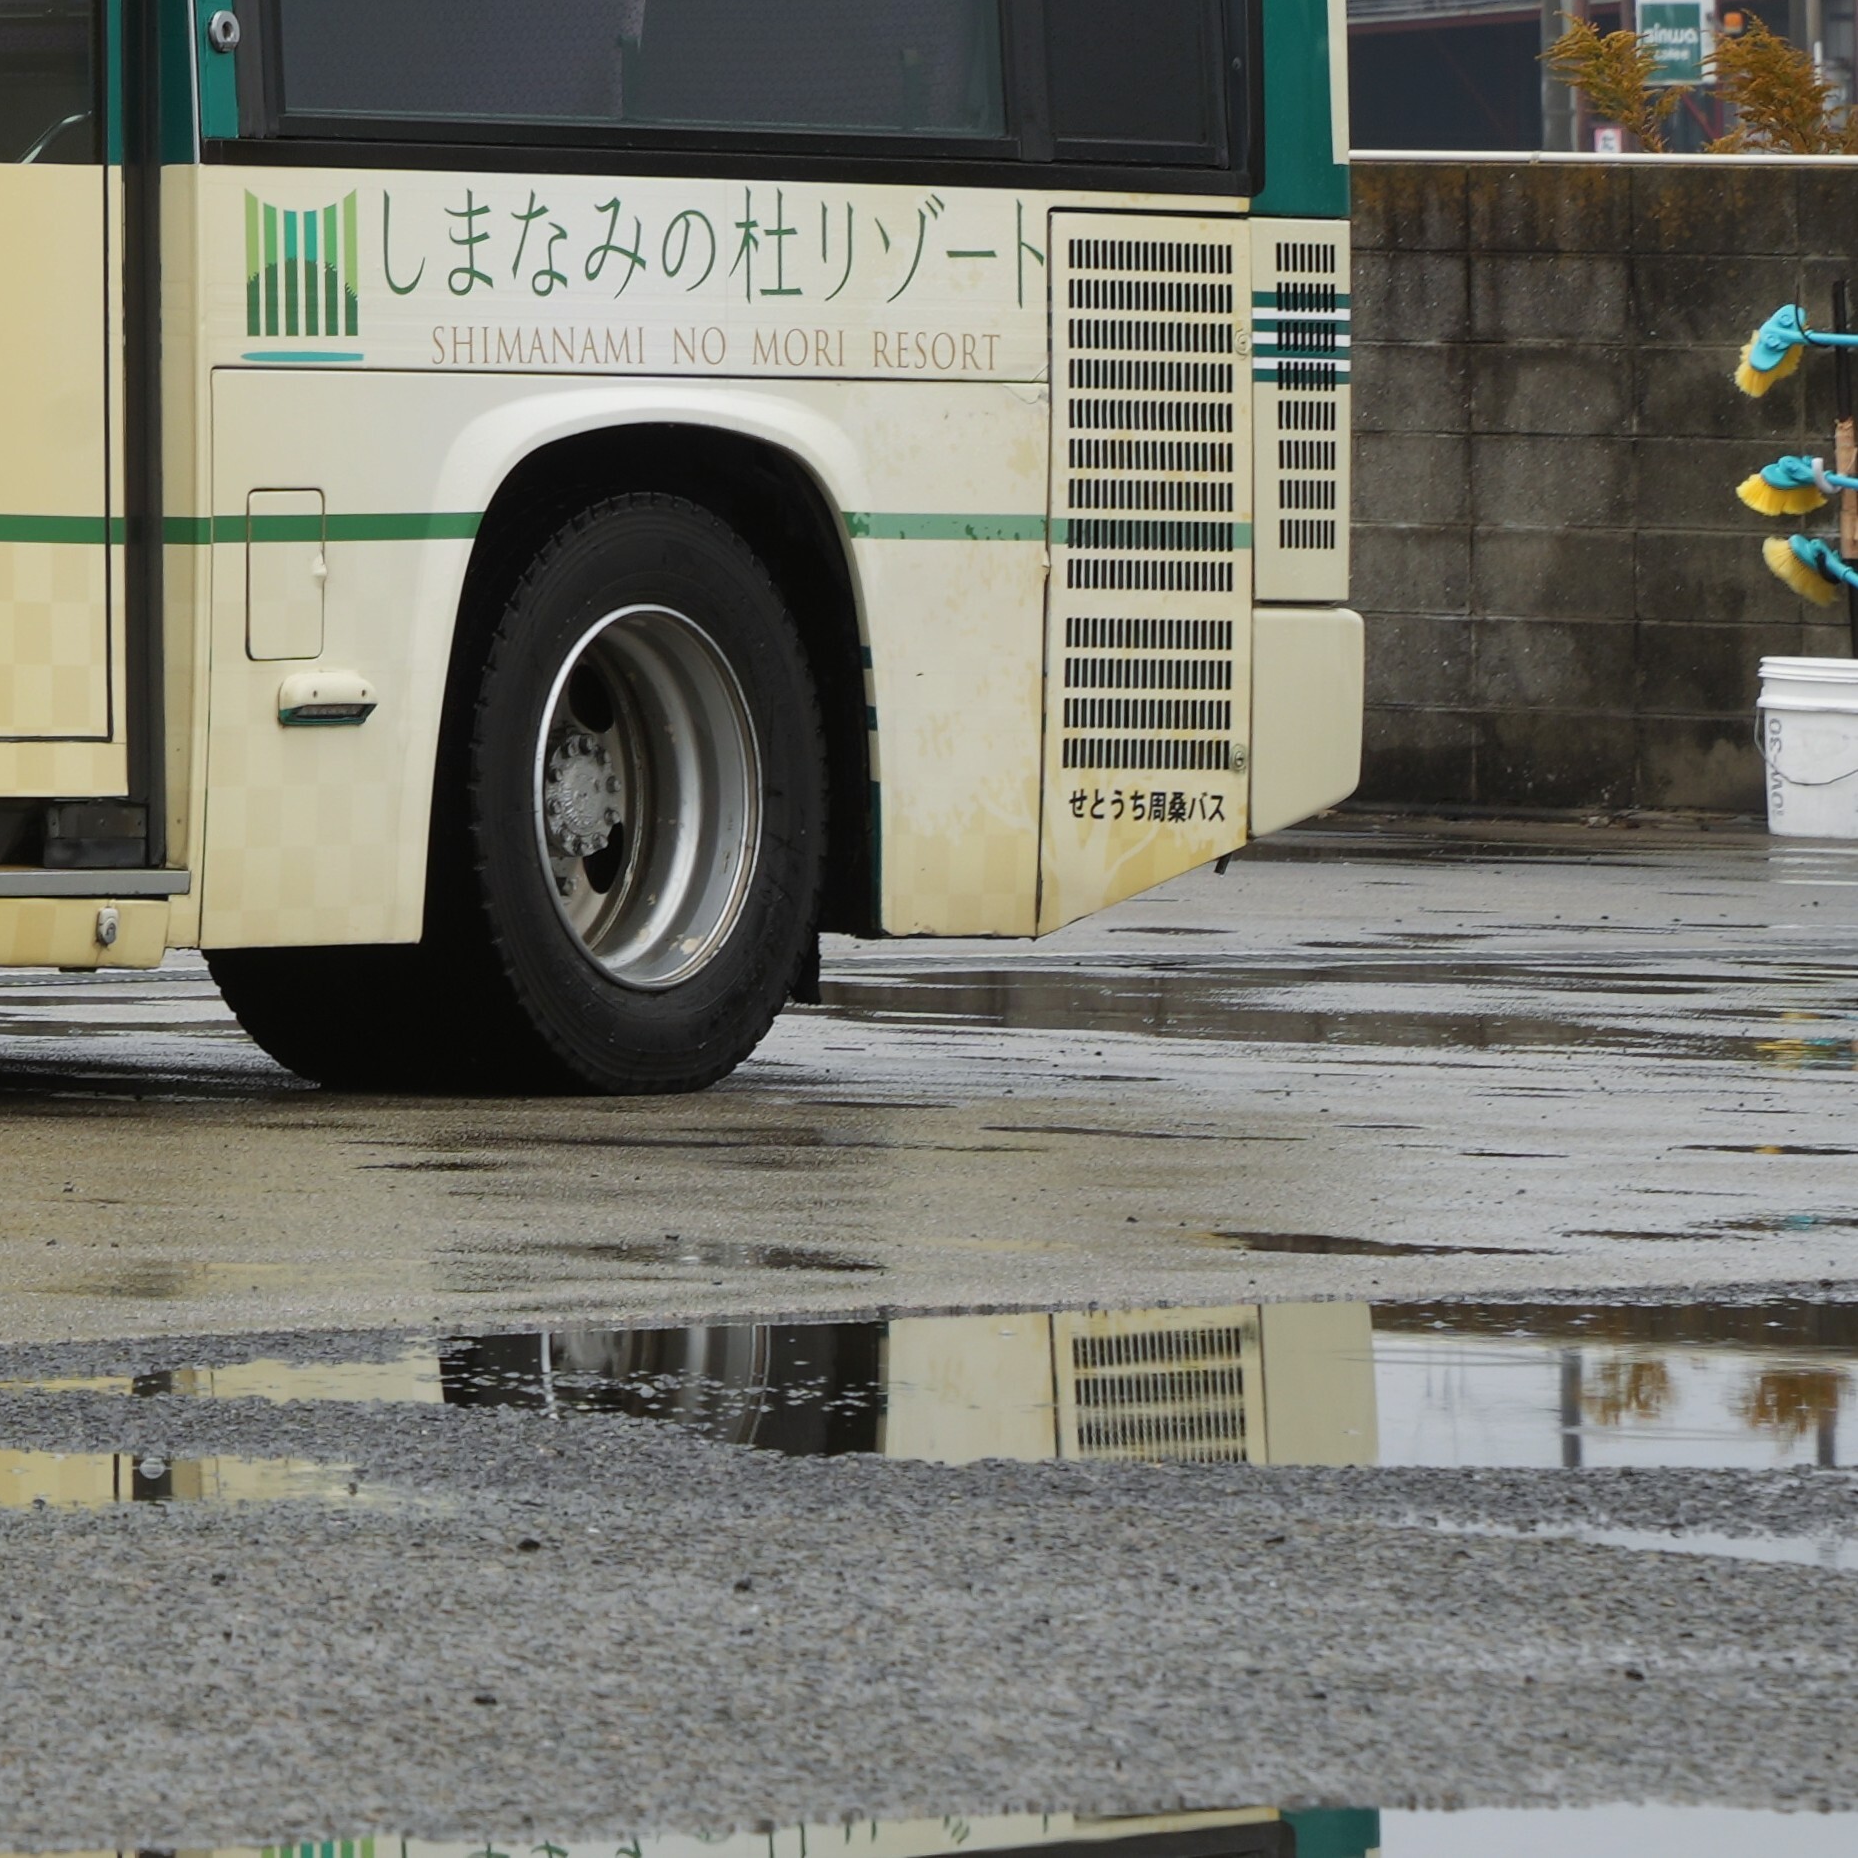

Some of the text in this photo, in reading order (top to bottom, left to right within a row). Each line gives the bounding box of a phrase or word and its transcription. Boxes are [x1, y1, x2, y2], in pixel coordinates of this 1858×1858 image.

[381, 186, 1047, 310] しまなみの杜リゾート
[431, 325, 1002, 373] SHIMANAMI NO MORI RESORT
[1068, 789, 1226, 823] せとうち周桑バス
